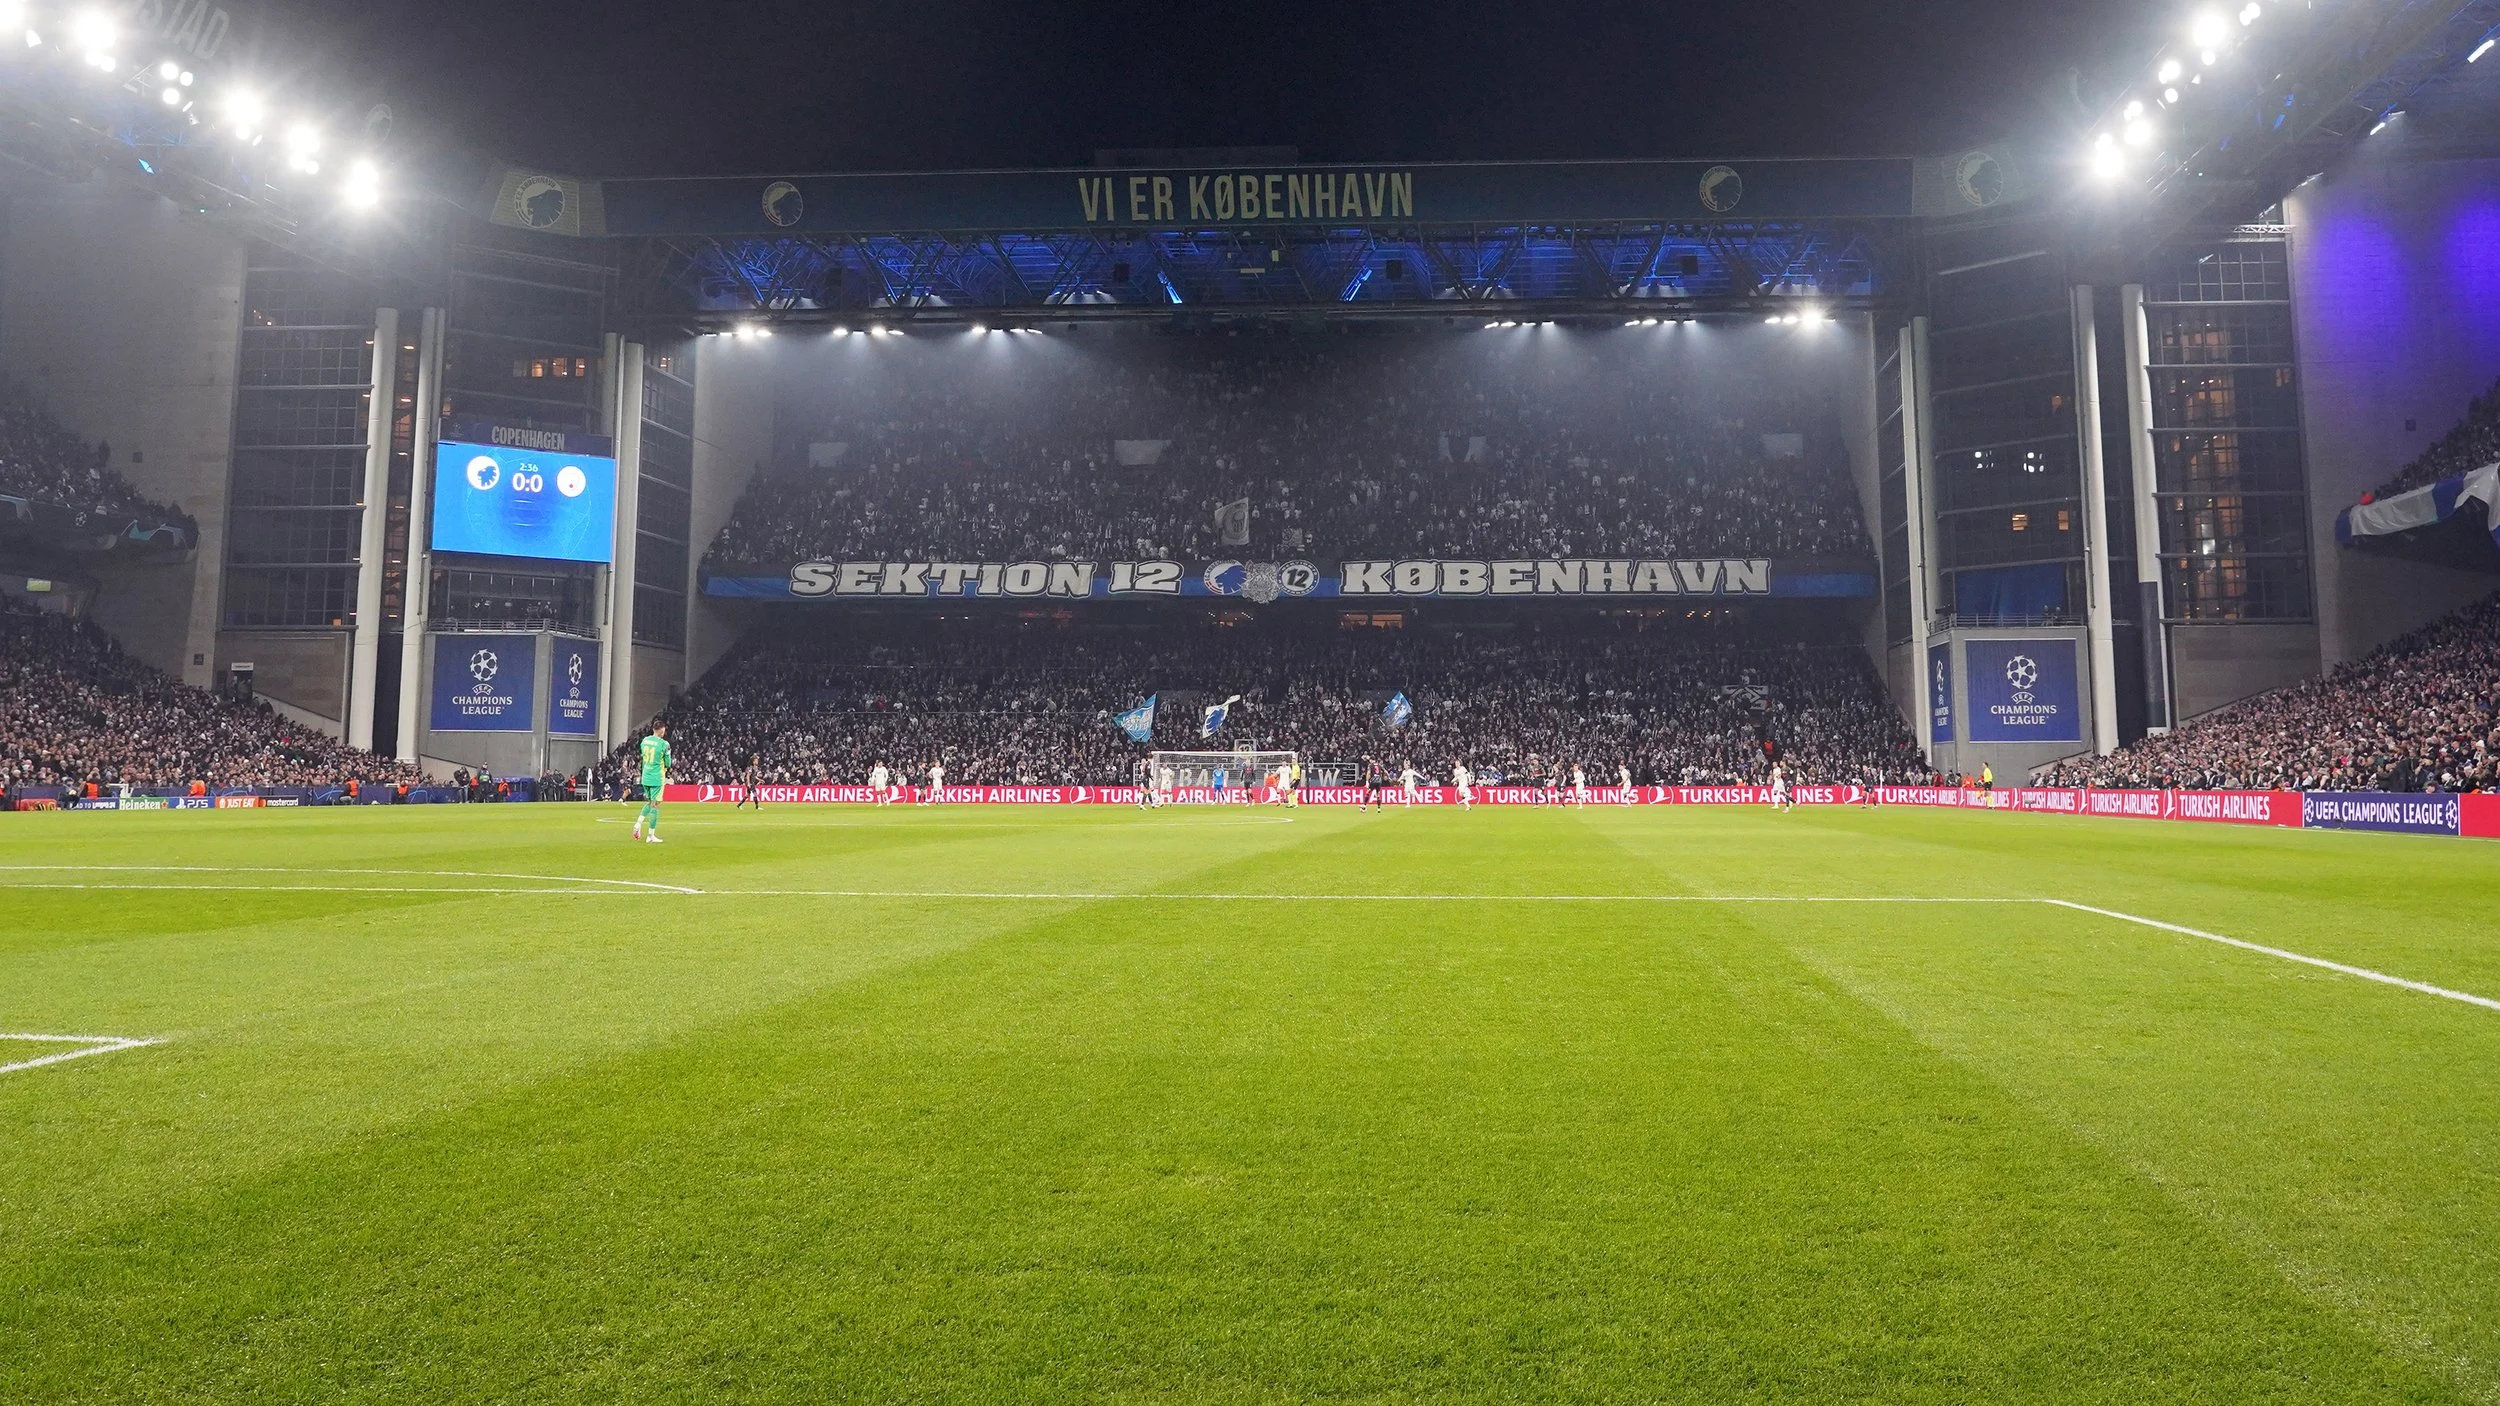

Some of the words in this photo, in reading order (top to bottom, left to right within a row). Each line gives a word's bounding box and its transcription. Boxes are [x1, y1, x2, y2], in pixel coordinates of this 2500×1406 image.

[1078, 177, 1114, 221] VI
[1130, 176, 1174, 220] ER
[1189, 173, 1413, 221] KØBENHAVN
[491, 426, 565, 451] COPENHAGEN
[519, 463, 538, 472] 2:36
[512, 473, 543, 492] 0:0
[792, 560, 1096, 597] SEKTION
[1108, 560, 1183, 595] 12
[1287, 569, 1310, 588] 12
[1340, 558, 1771, 595] KØBENHAVN
[473, 685, 492, 694] UEFA
[452, 696, 513, 705] CHAMPIONS
[560, 698, 589, 709] CHAMPIONS
[2013, 693, 2033, 703] UEFA
[462, 706, 501, 715] LEAGUE
[564, 709, 584, 718] LEAGUE
[1991, 705, 2057, 714] CHAMPIONS
[2003, 716, 2046, 725] LEAGUE
[267, 798, 298, 806] mastercard
[803, 788, 874, 802] AIRLINES
[989, 789, 1061, 803] AIRLINES
[1680, 789, 1753, 803] TURKISH
[1875, 788, 1937, 804] TURKISH
[2047, 792, 2074, 811] AIRLINES
[120, 799, 160, 810] Heineken
[187, 799, 208, 808] PS5
[227, 798, 241, 808] JUST
[243, 798, 255, 808] EAT
[2091, 793, 2121, 813] TURKISH
[2123, 794, 2159, 815] AIRLINES
[2179, 794, 2220, 818] TURKISH
[2222, 796, 2270, 820] AIRLINES
[2316, 801, 2340, 820] UEFA
[2342, 801, 2400, 823] CHAMPIONS
[2403, 803, 2443, 825] LEAGUE
